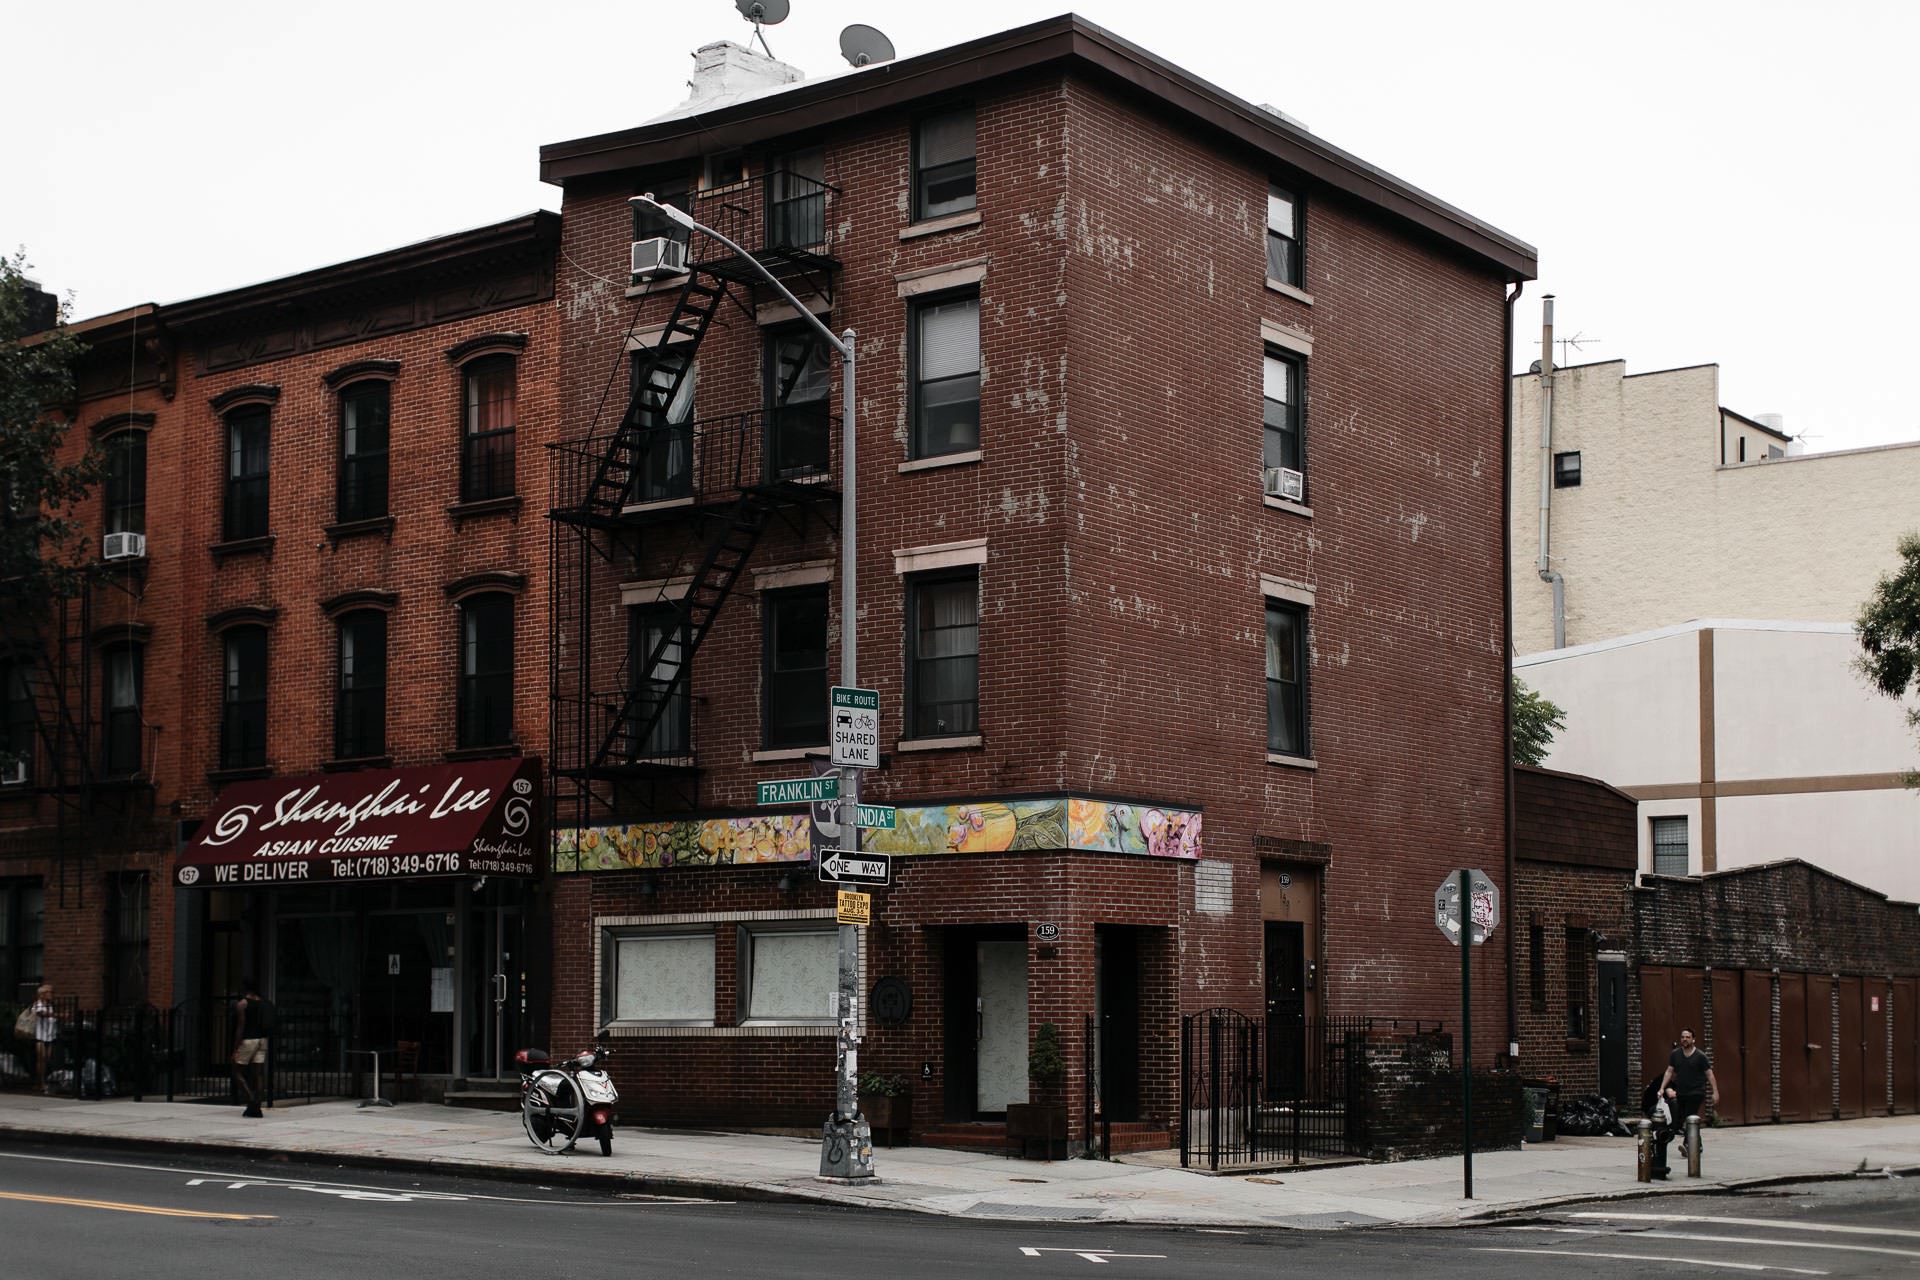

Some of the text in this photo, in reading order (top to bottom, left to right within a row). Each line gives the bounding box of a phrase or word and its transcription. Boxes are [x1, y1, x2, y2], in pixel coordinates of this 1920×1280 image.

[836, 693, 876, 706] BIKE ROUTE
[835, 731, 876, 746] SHARED
[842, 747, 869, 760] LANE
[515, 782, 529, 792] 157
[762, 780, 834, 802] FRANKLIN ST
[259, 777, 491, 836] Shanghai Lee
[857, 807, 894, 827] INDIA ST
[253, 834, 398, 857] ASIAN CUISINE
[472, 838, 533, 859] Shanghai Lee
[391, 852, 460, 874] 349-6716
[829, 860, 884, 875] ONE WAY
[182, 870, 196, 881] 157
[214, 861, 309, 883] WE DELIVER
[1041, 925, 1055, 935] 159
